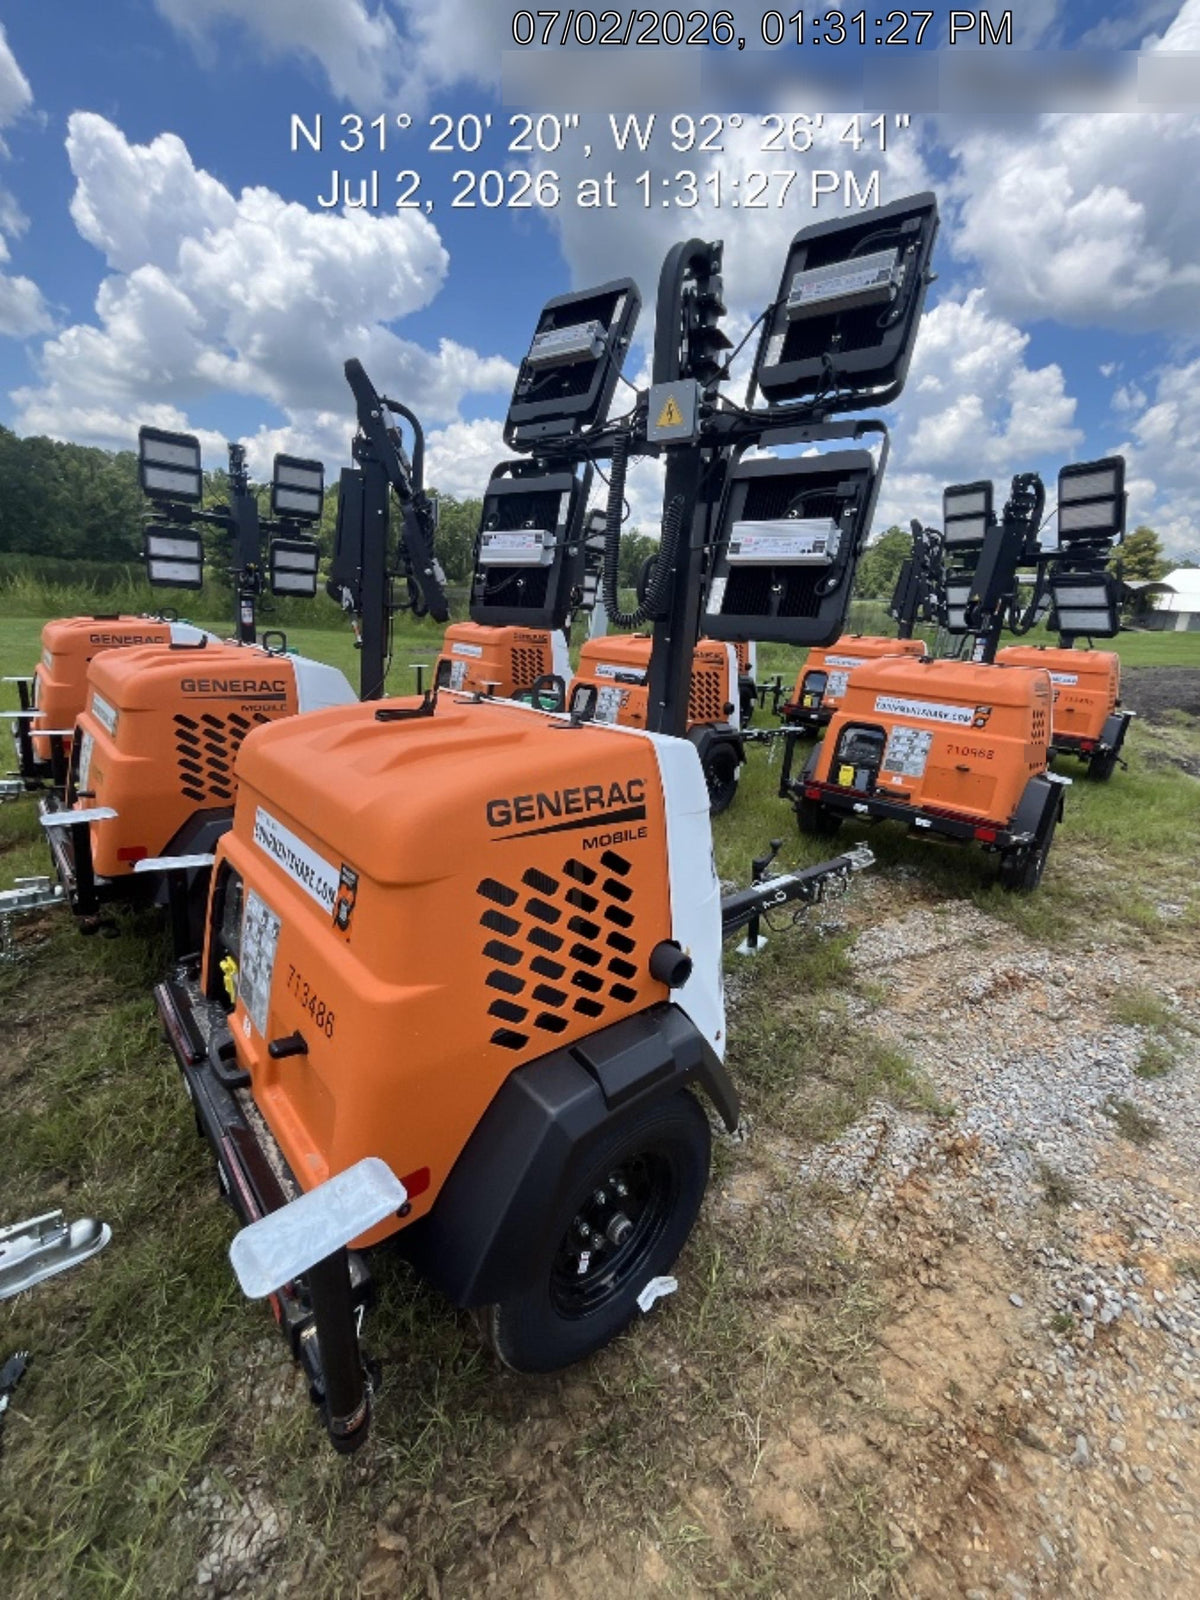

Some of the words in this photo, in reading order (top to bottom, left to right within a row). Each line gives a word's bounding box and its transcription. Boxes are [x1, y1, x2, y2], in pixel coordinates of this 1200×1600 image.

[90, 634, 164, 644] GENERAC
[181, 679, 286, 693] GENERAC
[241, 703, 287, 712] MOBILE
[486, 778, 646, 827] GENERAC
[582, 826, 648, 850] MOBILE
[287, 964, 336, 1039] 713486
